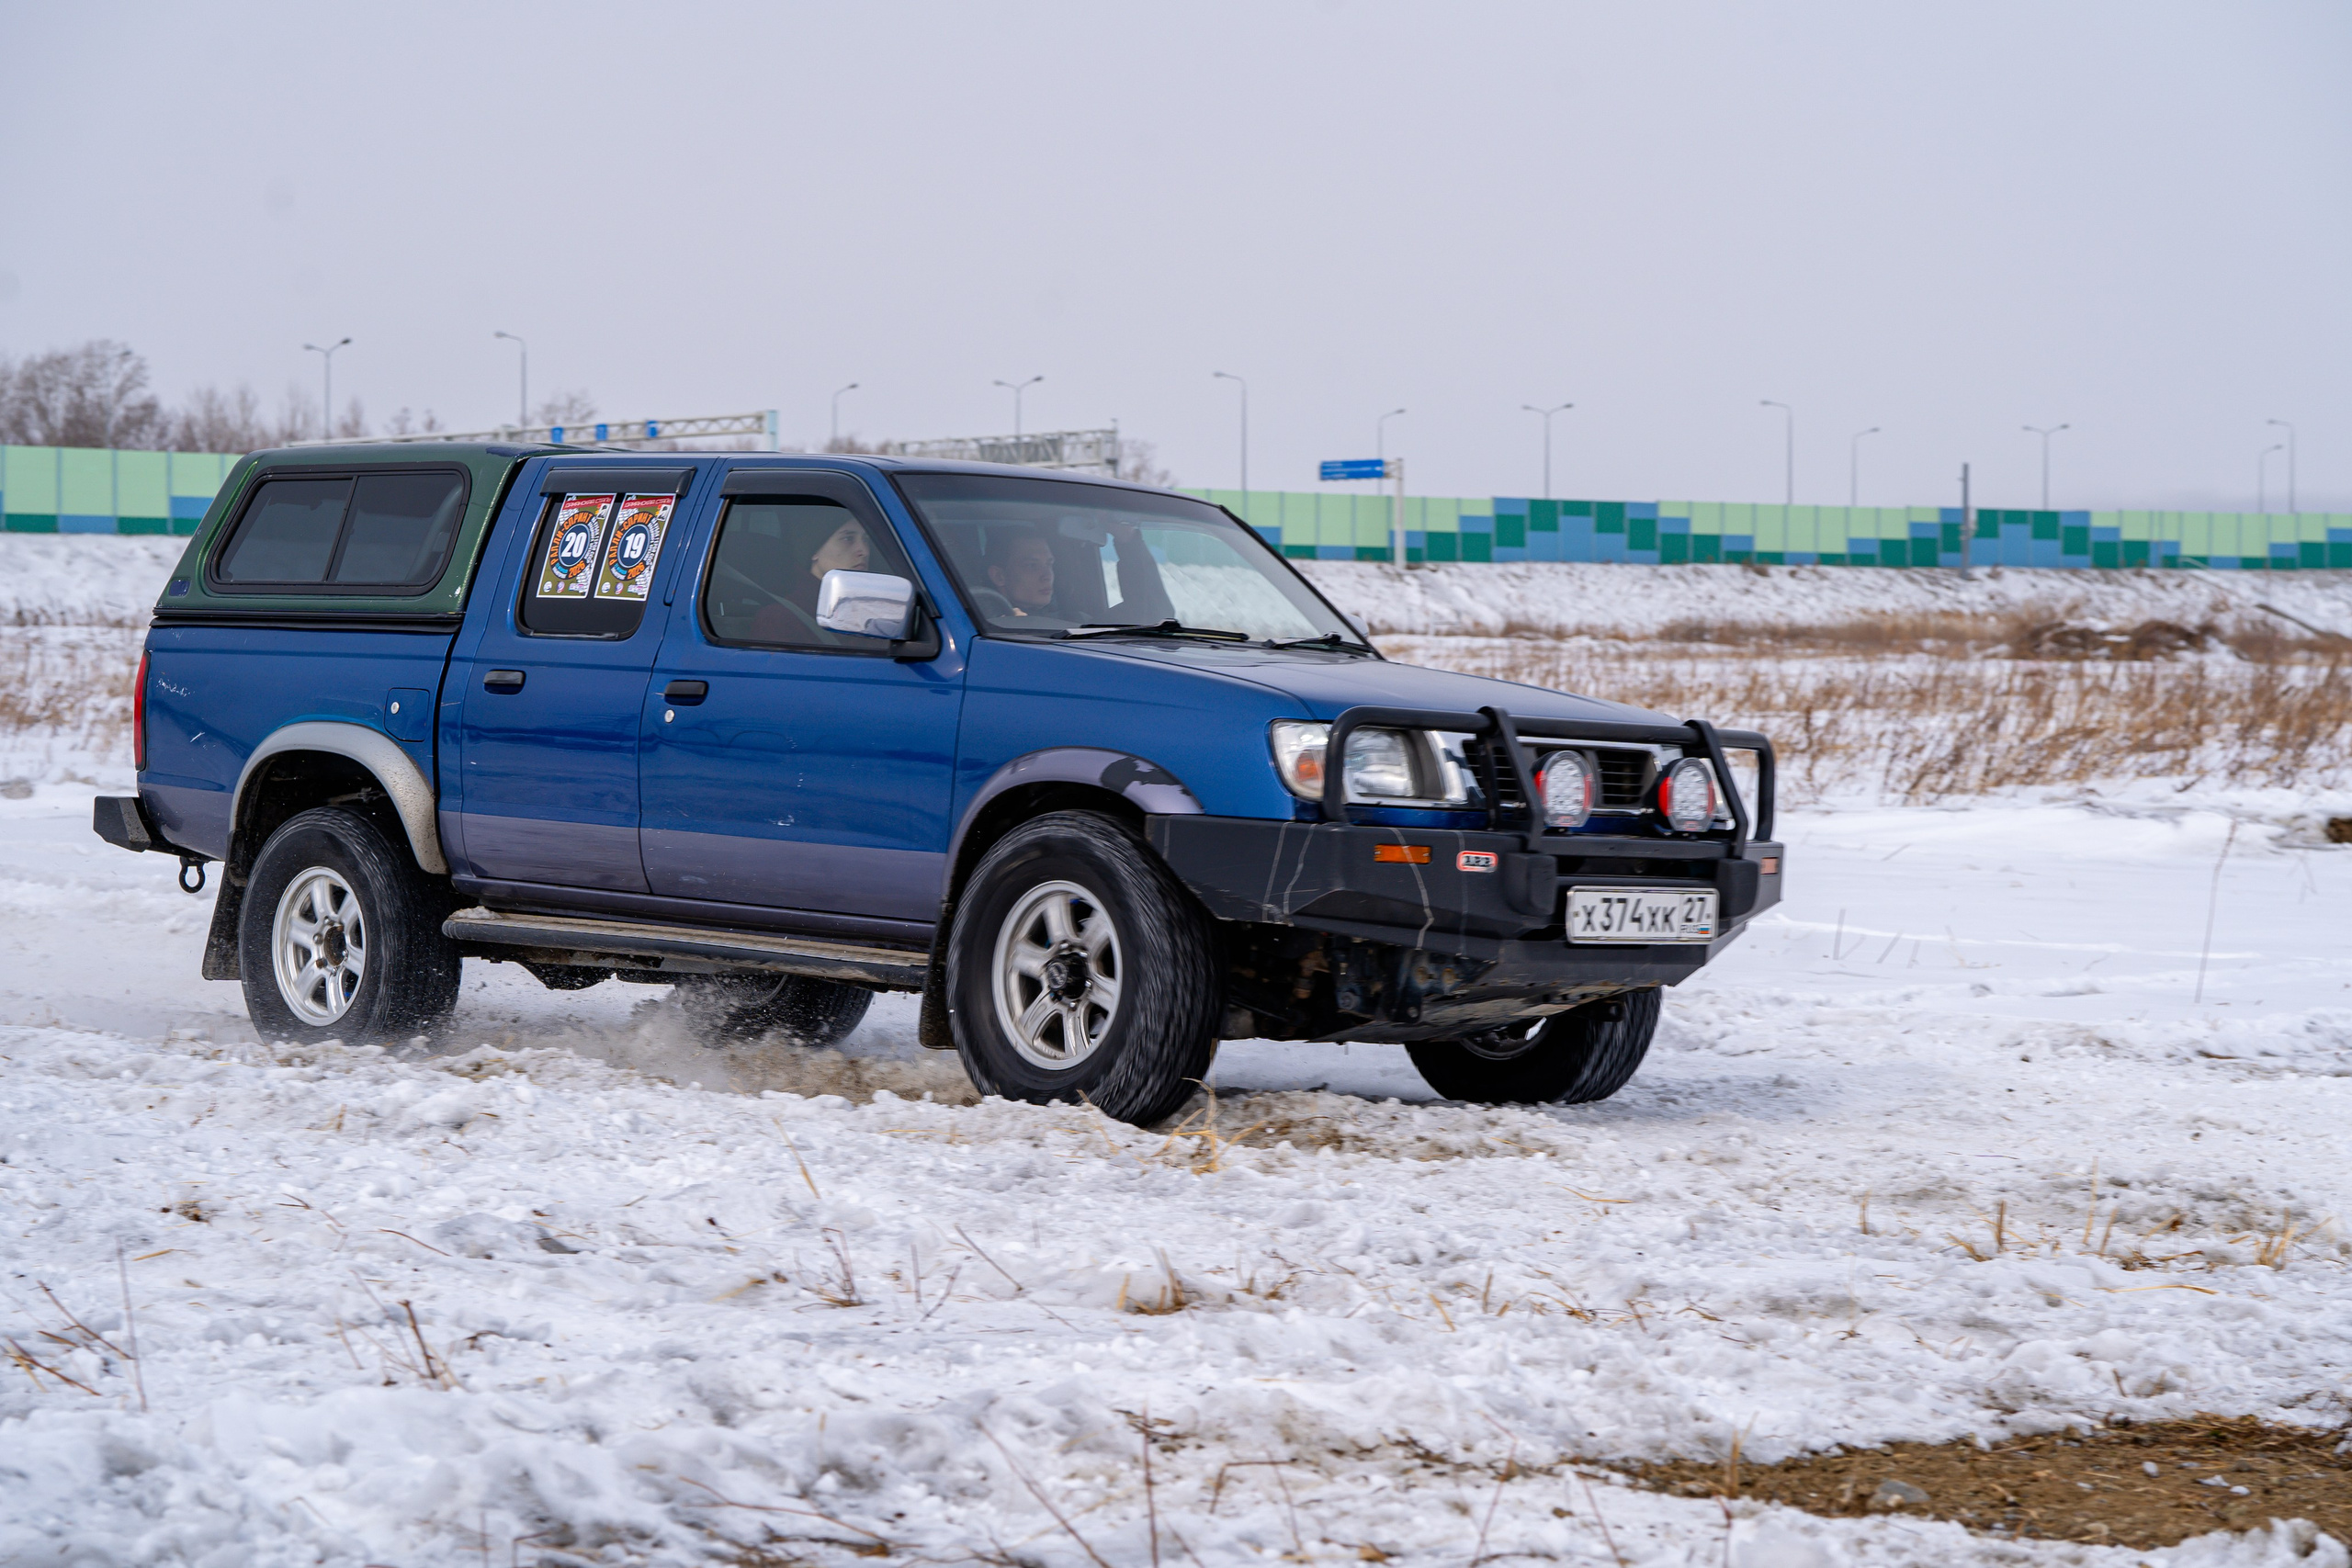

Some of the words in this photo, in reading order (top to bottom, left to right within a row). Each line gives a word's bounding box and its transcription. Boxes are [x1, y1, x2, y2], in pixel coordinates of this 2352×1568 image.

[560, 531, 587, 558] 20
[623, 533, 646, 558] 19
[1683, 897, 1707, 922] 27
